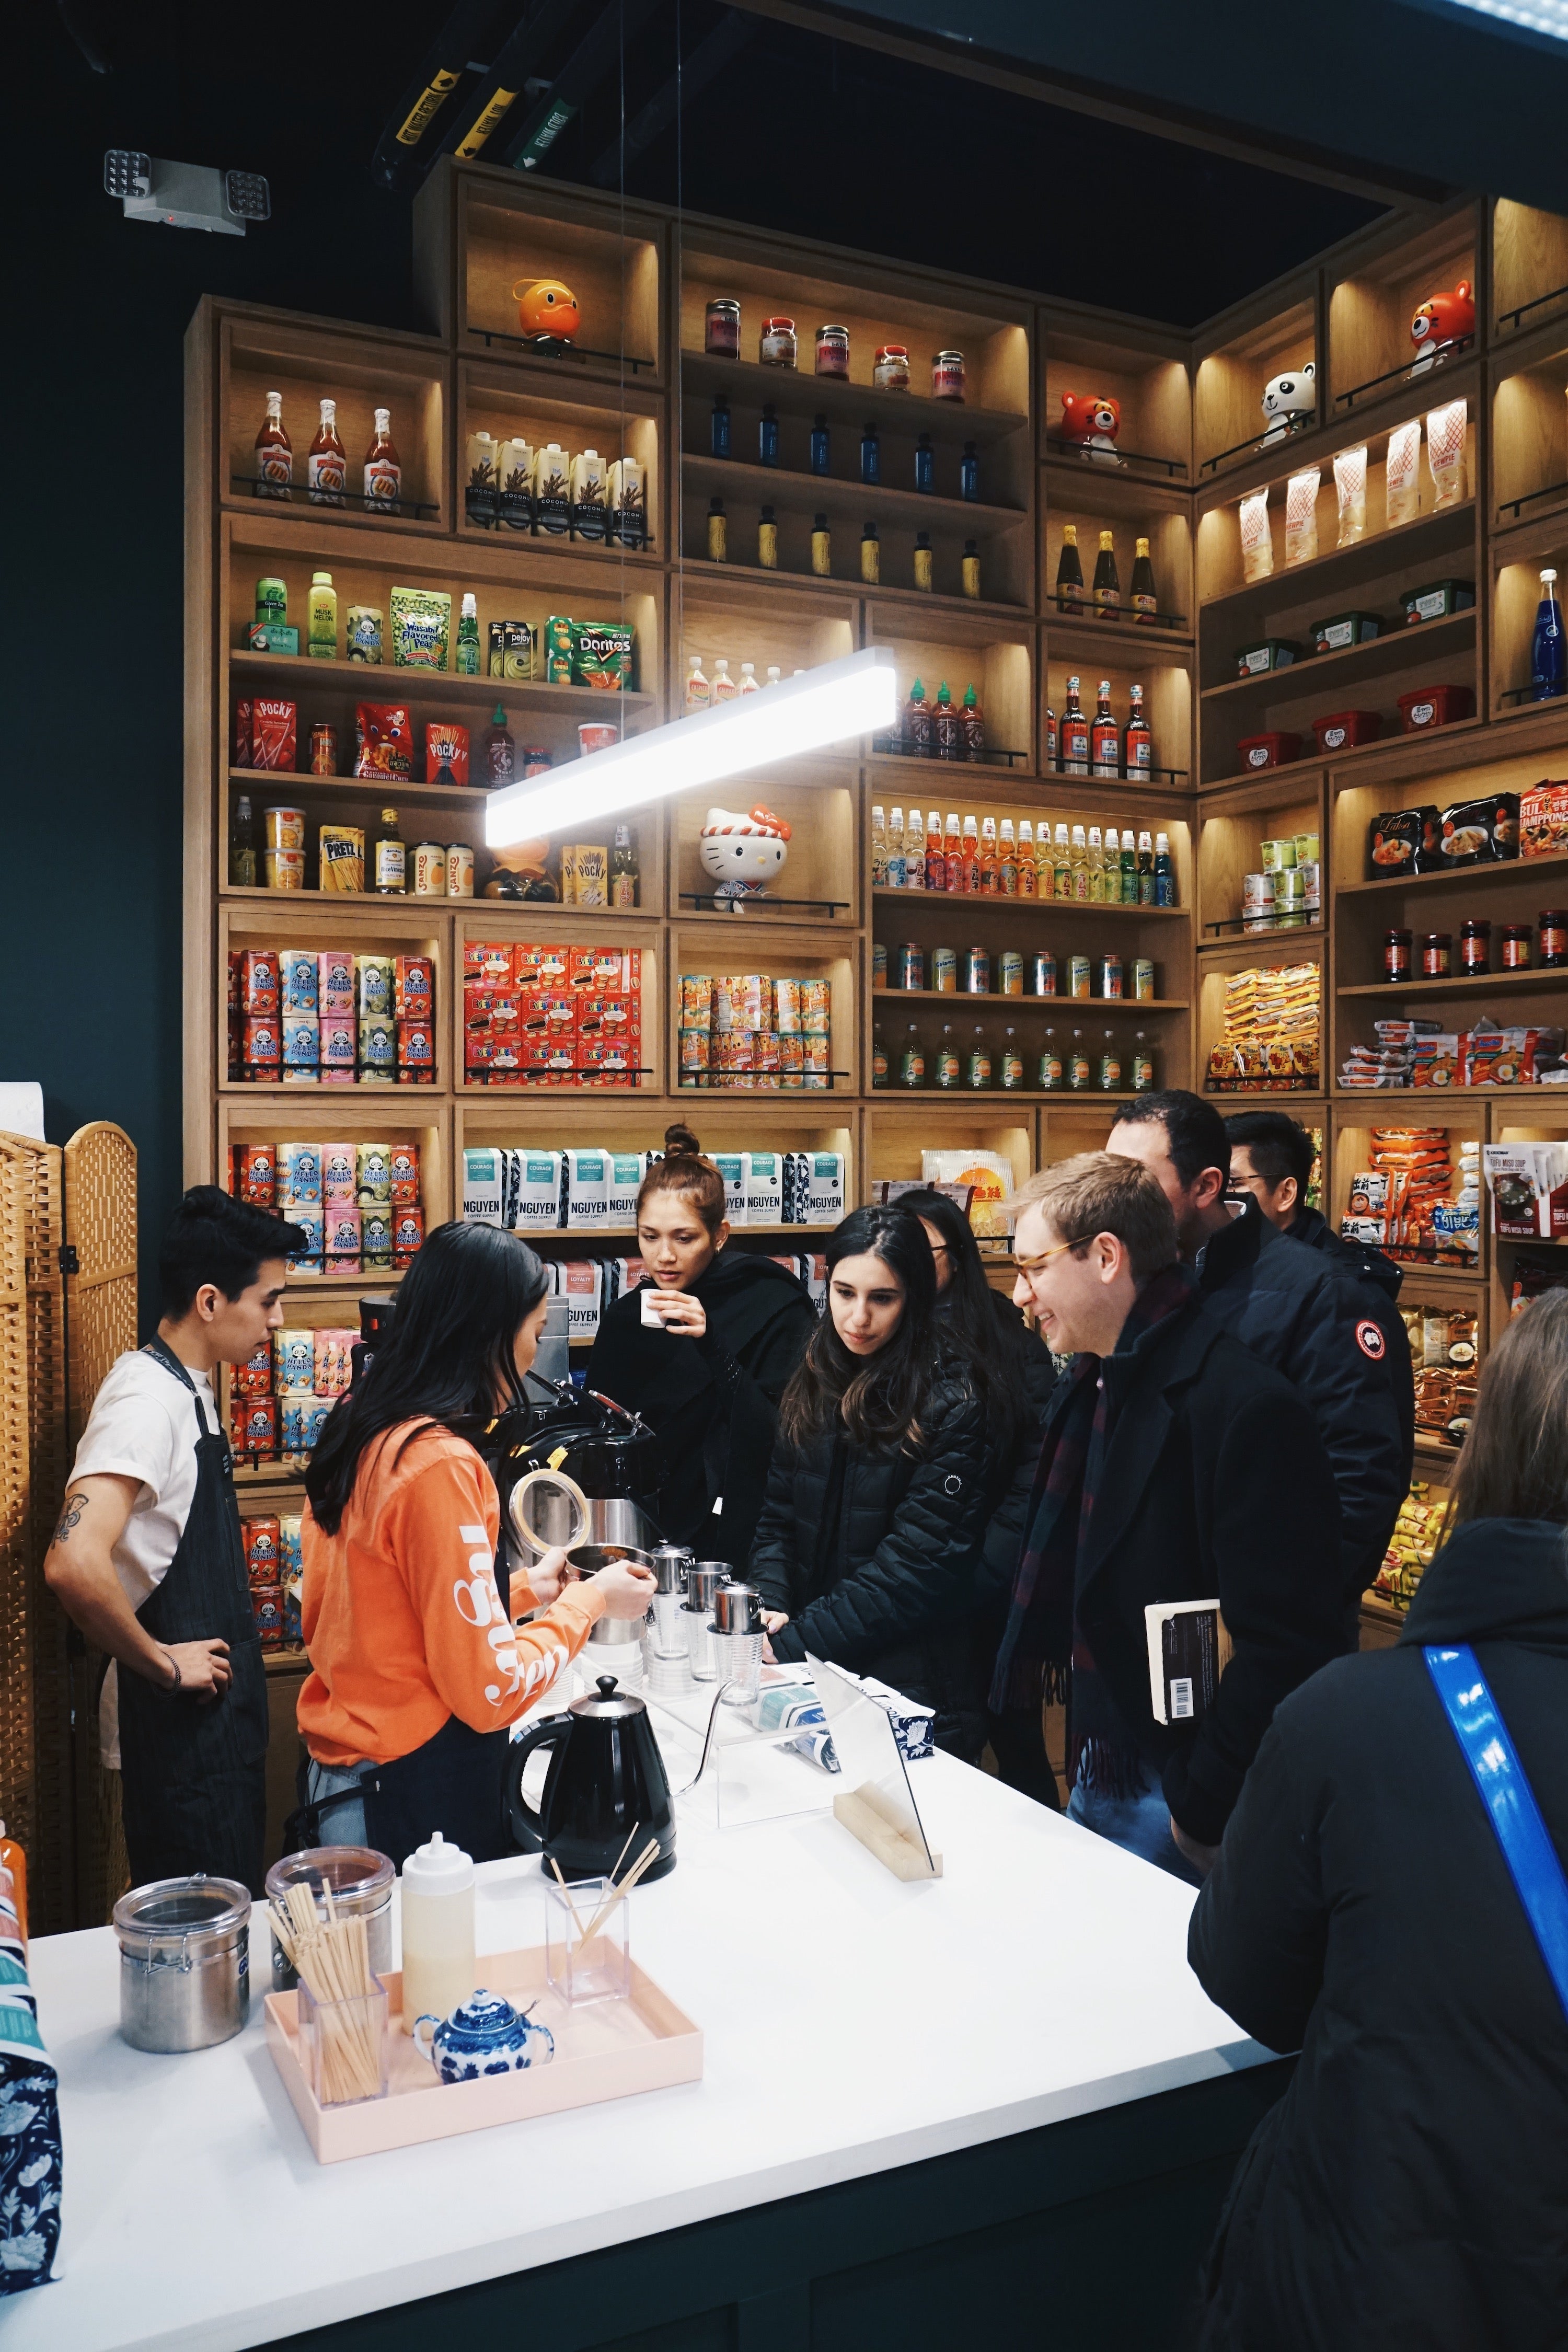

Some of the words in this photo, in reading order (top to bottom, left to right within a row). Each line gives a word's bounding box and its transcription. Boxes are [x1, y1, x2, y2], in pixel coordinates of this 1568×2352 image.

[476, 112, 498, 134] WATER
[548, 112, 569, 132] COLD
[534, 128, 558, 148] WATER
[1434, 453, 1455, 468] KEWPIE
[406, 622, 439, 633] Wasabi
[402, 631, 438, 642] Flavored
[414, 638, 433, 648] Peas
[511, 633, 531, 643] pejoy
[580, 637, 630, 652] Doritos
[363, 770, 392, 781] Caramel
[1519, 803, 1543, 818] BUL
[1379, 818, 1410, 832] Laksa
[327, 841, 356, 859] PRETZ
[419, 855, 428, 891] SANZO
[450, 856, 459, 893] SANZO
[896, 858, 906, 886] ラムネ
[916, 861, 925, 888] ラムネ
[971, 865, 979, 890] ラムネ
[1007, 867, 1016, 893] ラムネ
[1025, 869, 1034, 894] ラムネ
[1045, 872, 1054, 896] ラムネ
[1063, 871, 1071, 897] ラムネ
[1078, 873, 1087, 898] ラムネ
[1353, 1176, 1389, 1191] 出前一丁
[464, 1201, 499, 1213] NGUYEN
[520, 1202, 556, 1214] NGUYEN
[571, 1202, 607, 1214] NGUYEN
[748, 1196, 780, 1207] NGUYEN
[810, 1197, 841, 1208] NGUYEN
[1342, 1220, 1382, 1234] 出前一丁
[568, 1310, 597, 1321] GUYEN
